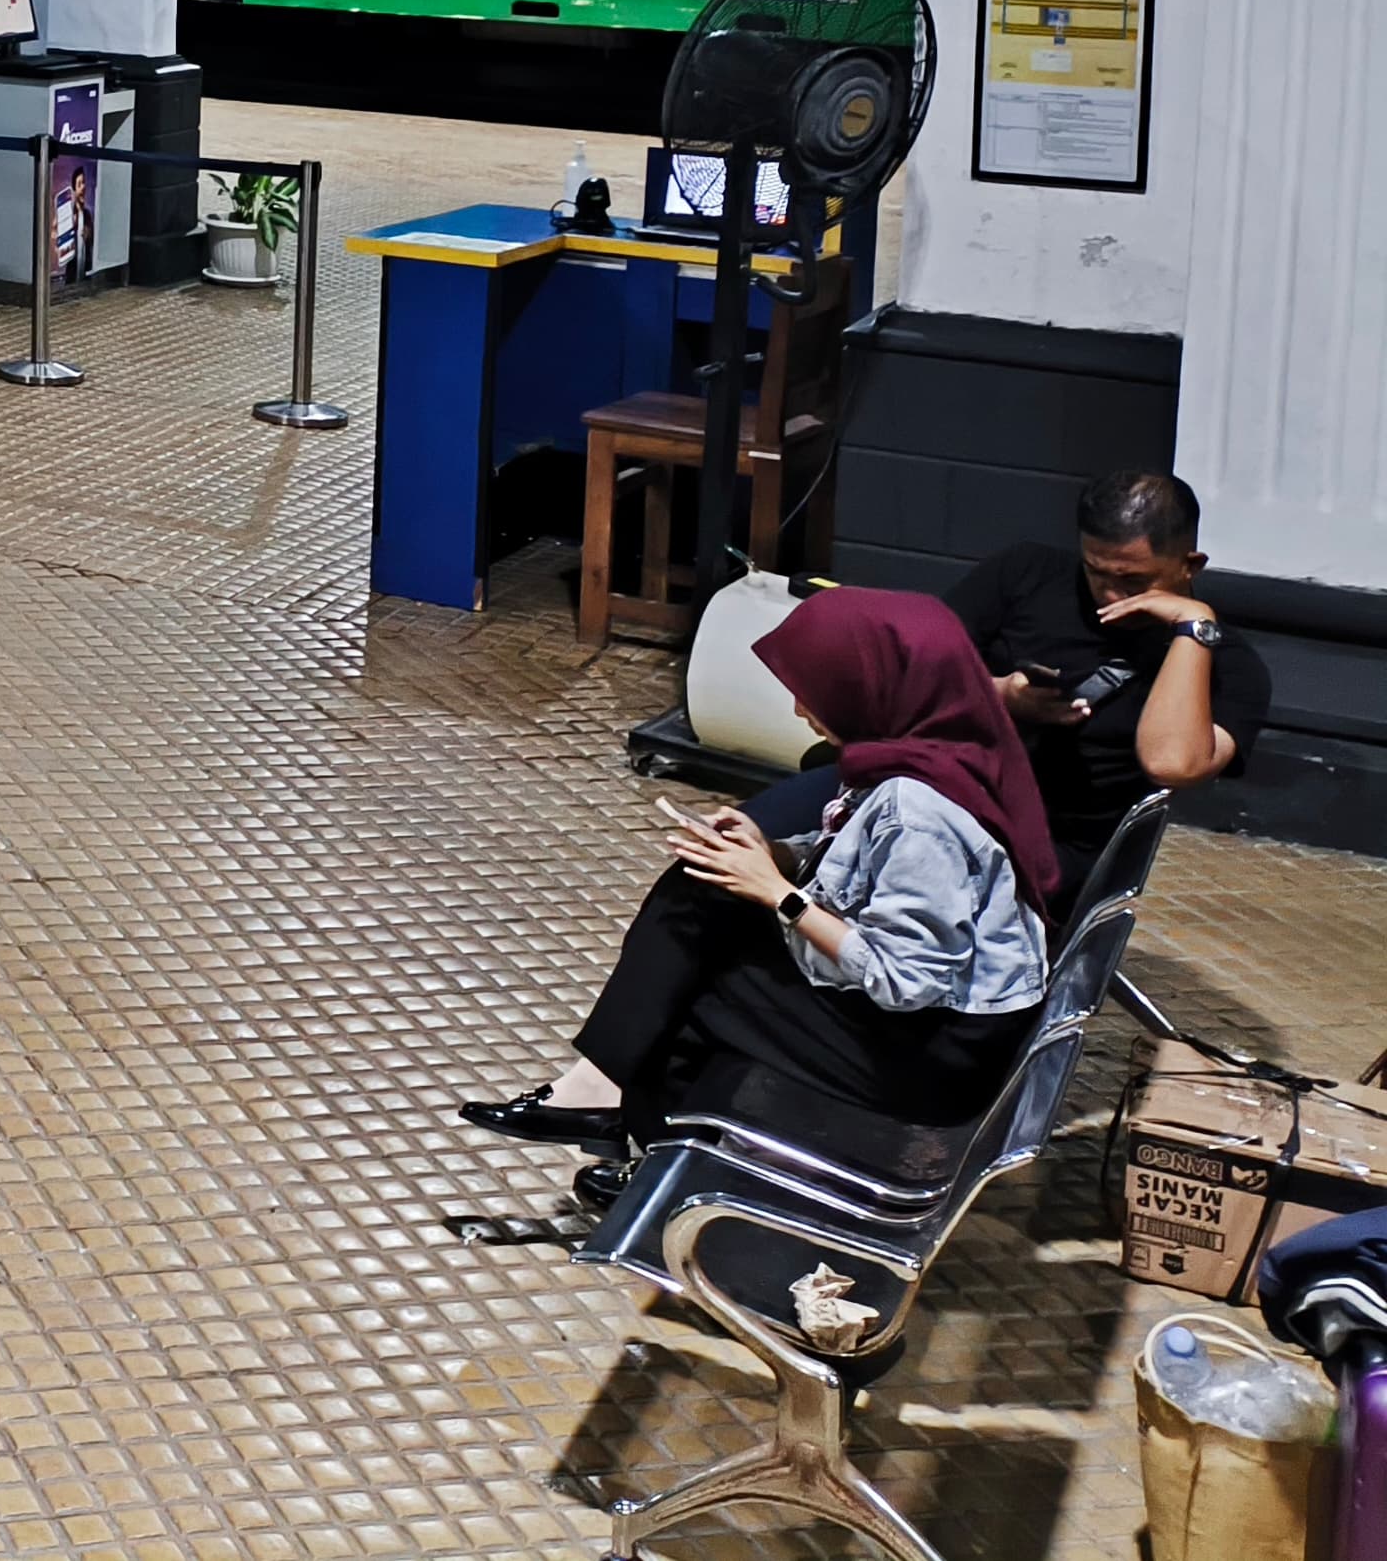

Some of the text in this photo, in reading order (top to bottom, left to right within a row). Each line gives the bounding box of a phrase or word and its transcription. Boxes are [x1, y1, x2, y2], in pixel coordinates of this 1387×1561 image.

[1136, 1144, 1224, 1181] BANGO
[1137, 1173, 1224, 1207] MANIS
[1136, 1192, 1222, 1225] KECAP
